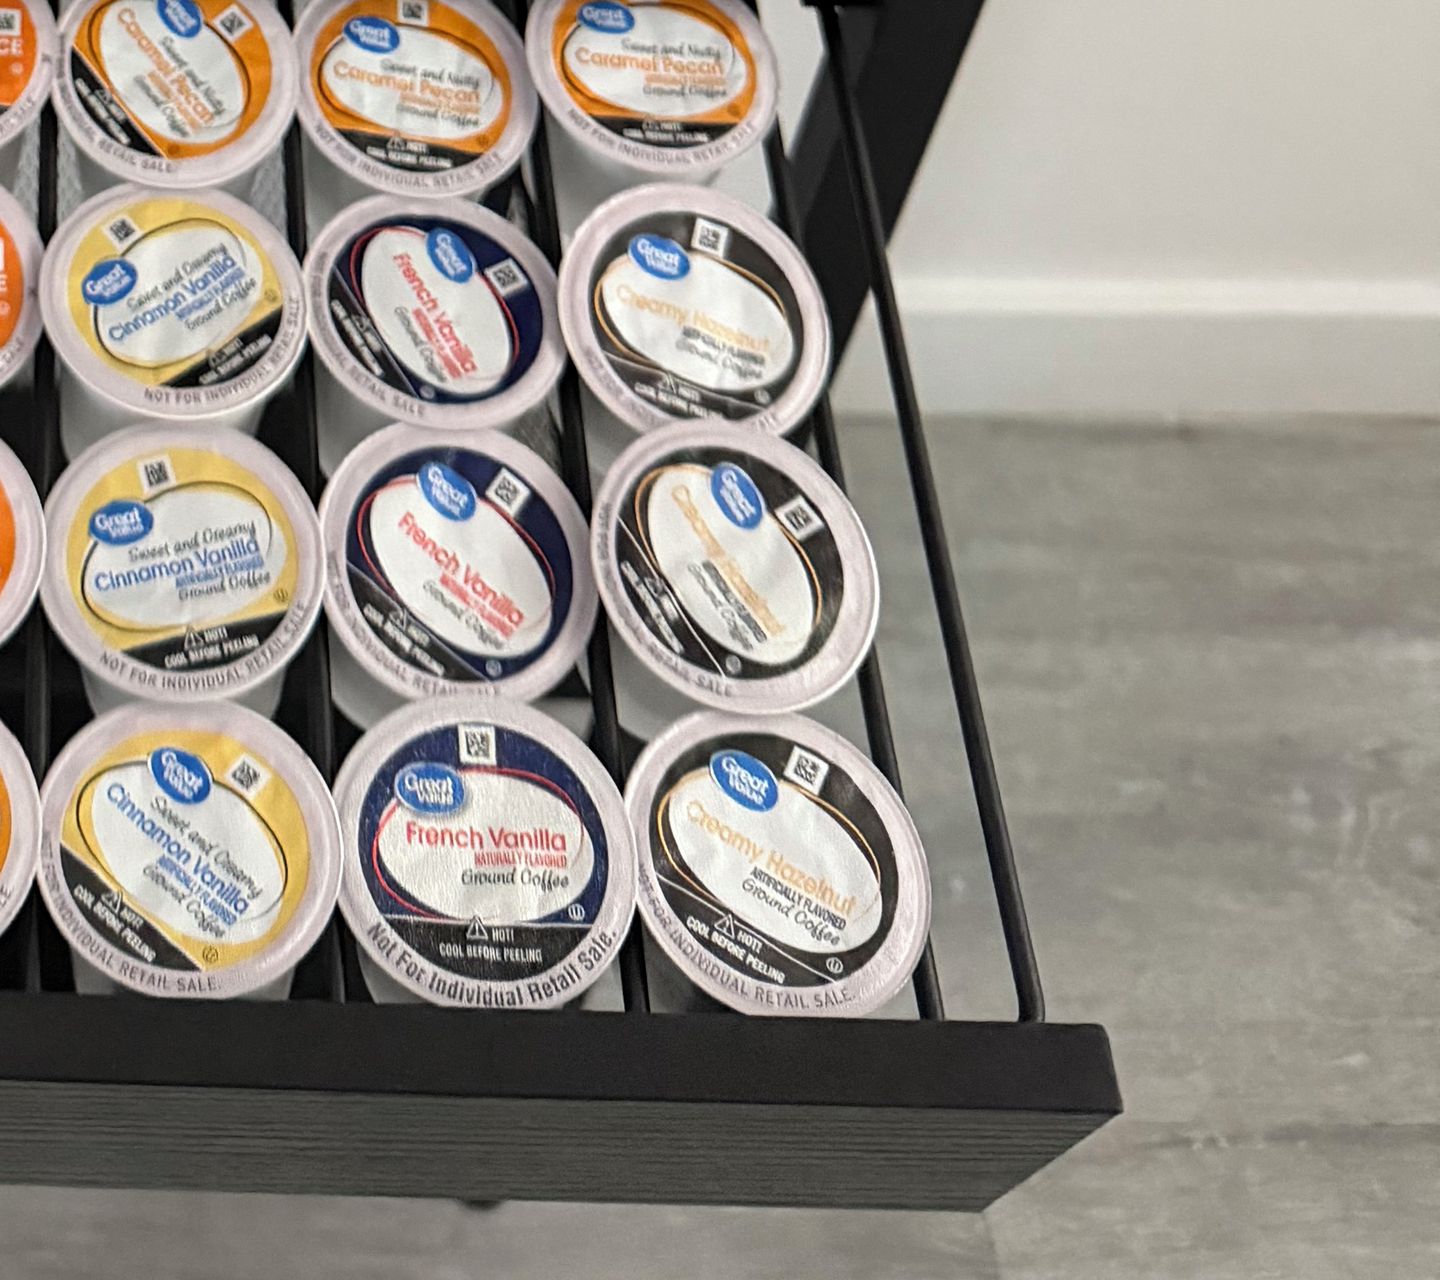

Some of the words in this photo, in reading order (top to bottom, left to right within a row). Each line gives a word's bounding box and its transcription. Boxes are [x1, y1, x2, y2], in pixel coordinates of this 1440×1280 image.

[575, 46, 657, 72] Caramel
[663, 57, 725, 76] Pecan
[108, 291, 187, 342] Cinnamon
[184, 255, 236, 296] Vanilla
[95, 508, 140, 531] Great
[128, 544, 171, 562] Sweet
[174, 533, 200, 552] and
[202, 520, 257, 544] Creamy
[94, 556, 194, 592] Cinnamon
[194, 539, 260, 566] Vanilla
[398, 511, 460, 573] French
[462, 563, 525, 627] Vanilla
[130, 667, 156, 686] FOR
[162, 669, 242, 689] INDIVIDUAL
[248, 639, 284, 673] RETAIL
[161, 750, 203, 792] Great
[404, 773, 453, 793] Great
[721, 755, 769, 796] Great
[416, 788, 453, 805] Value
[107, 782, 191, 864] Cinnamon
[193, 855, 250, 915] Vanilla
[407, 821, 484, 849] French
[489, 826, 567, 852] Vanilla
[474, 851, 522, 867] NATURALLY
[524, 853, 567, 868] FLAVORED
[686, 800, 764, 864] Creamy
[767, 848, 857, 916] Hazelnut
[461, 869, 515, 887] Ground
[520, 869, 569, 891] Coffee
[142, 864, 186, 905] Ground
[186, 898, 226, 938] Coffee
[742, 879, 791, 915] Ground
[793, 910, 841, 946] Coffee
[802, 893, 847, 931] FLAVORED
[439, 942, 464, 957] COOL
[467, 943, 502, 960] BEFORE
[504, 946, 542, 963] PEELING
[492, 928, 515, 942] HOT!
[119, 962, 169, 989] RETAIL
[367, 920, 393, 957] Not
[395, 950, 424, 982] For
[428, 969, 524, 1007] Individual
[526, 963, 581, 1003] Retail
[583, 928, 617, 971] Sale.
[746, 954, 785, 984] PEELING
[755, 988, 810, 1009] RETAIL
